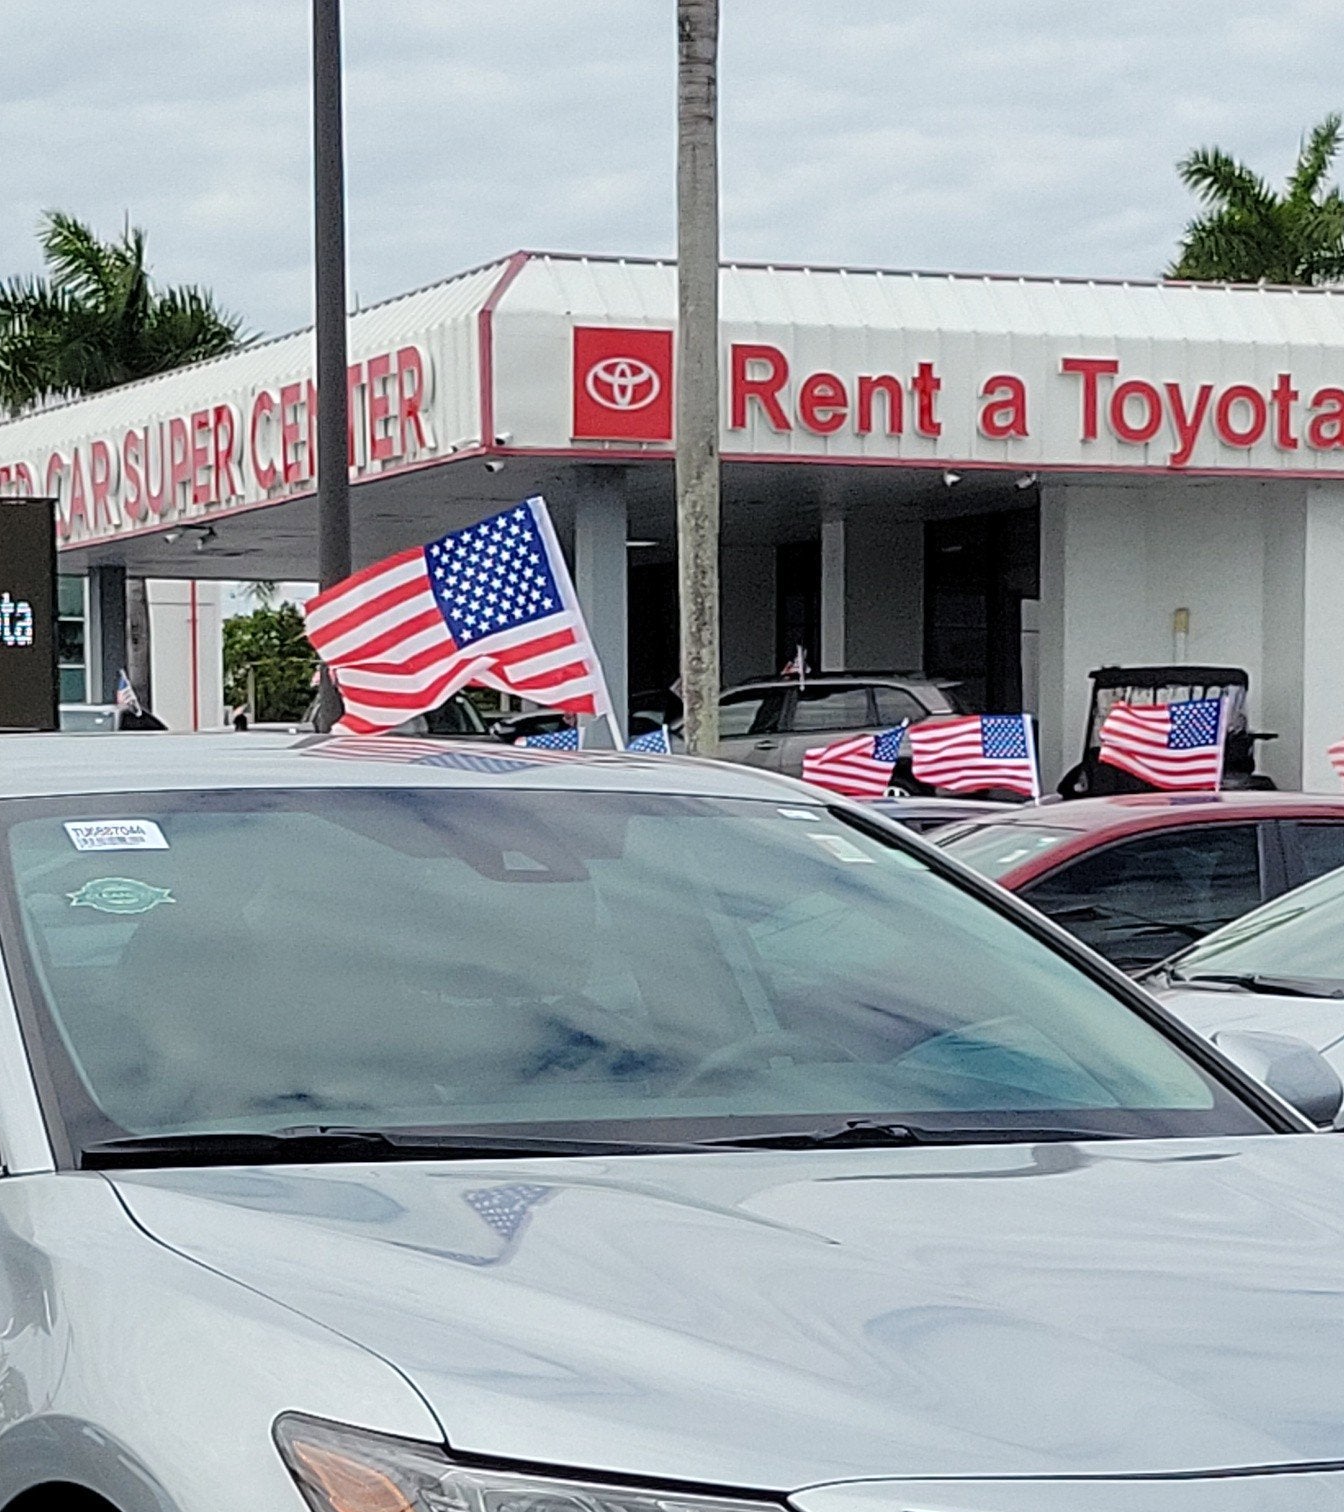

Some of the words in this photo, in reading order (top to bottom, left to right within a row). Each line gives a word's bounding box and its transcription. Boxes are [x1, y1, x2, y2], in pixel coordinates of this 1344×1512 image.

[730, 344, 942, 439] Rent
[981, 375, 1029, 438] a
[46, 441, 117, 540] CAR
[123, 402, 238, 524] SUPER
